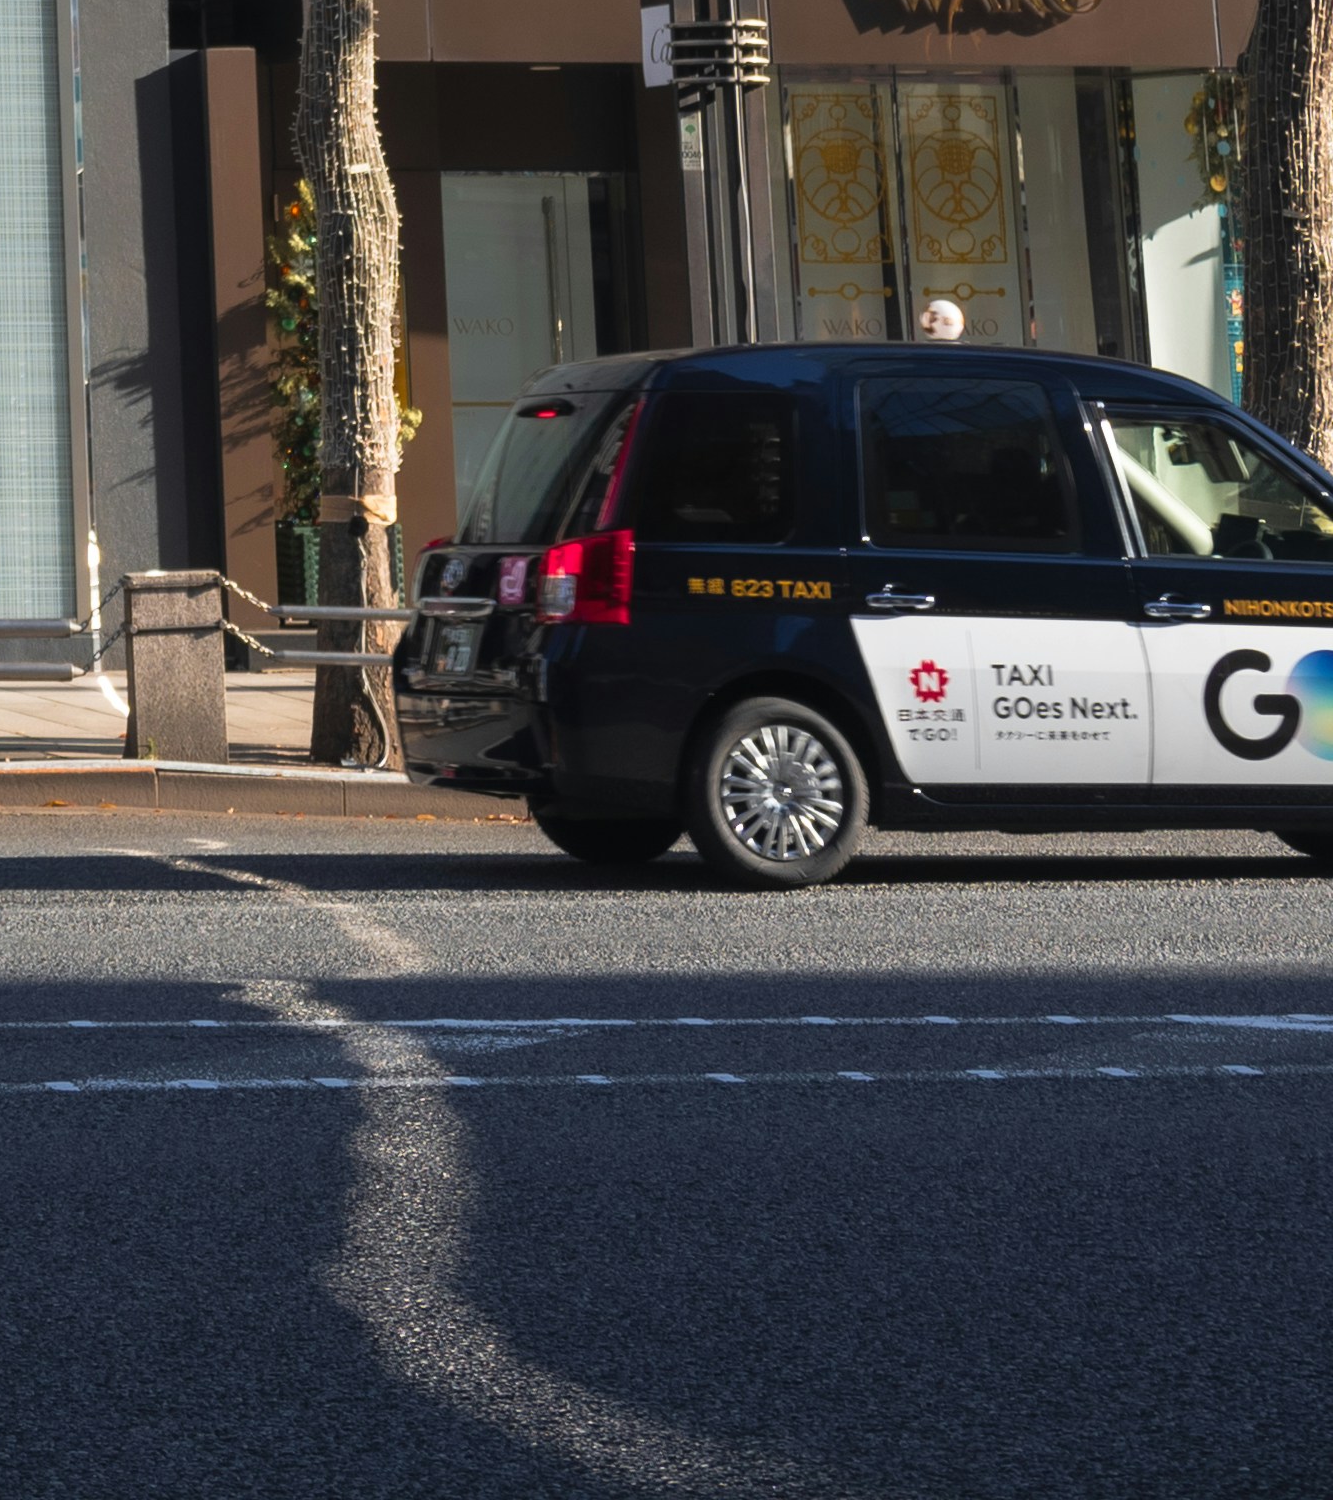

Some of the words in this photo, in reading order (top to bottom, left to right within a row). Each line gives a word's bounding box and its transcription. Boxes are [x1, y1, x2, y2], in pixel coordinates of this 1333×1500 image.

[454, 318, 515, 337] WAKO
[823, 318, 883, 337] WAKO
[960, 318, 1000, 337] AKO
[731, 578, 775, 600] 823
[776, 579, 833, 601] TAXI
[991, 664, 1055, 686] TAXI
[897, 708, 966, 722] 日本交通
[993, 697, 1064, 720] GOes
[1070, 697, 1139, 720] Next.
